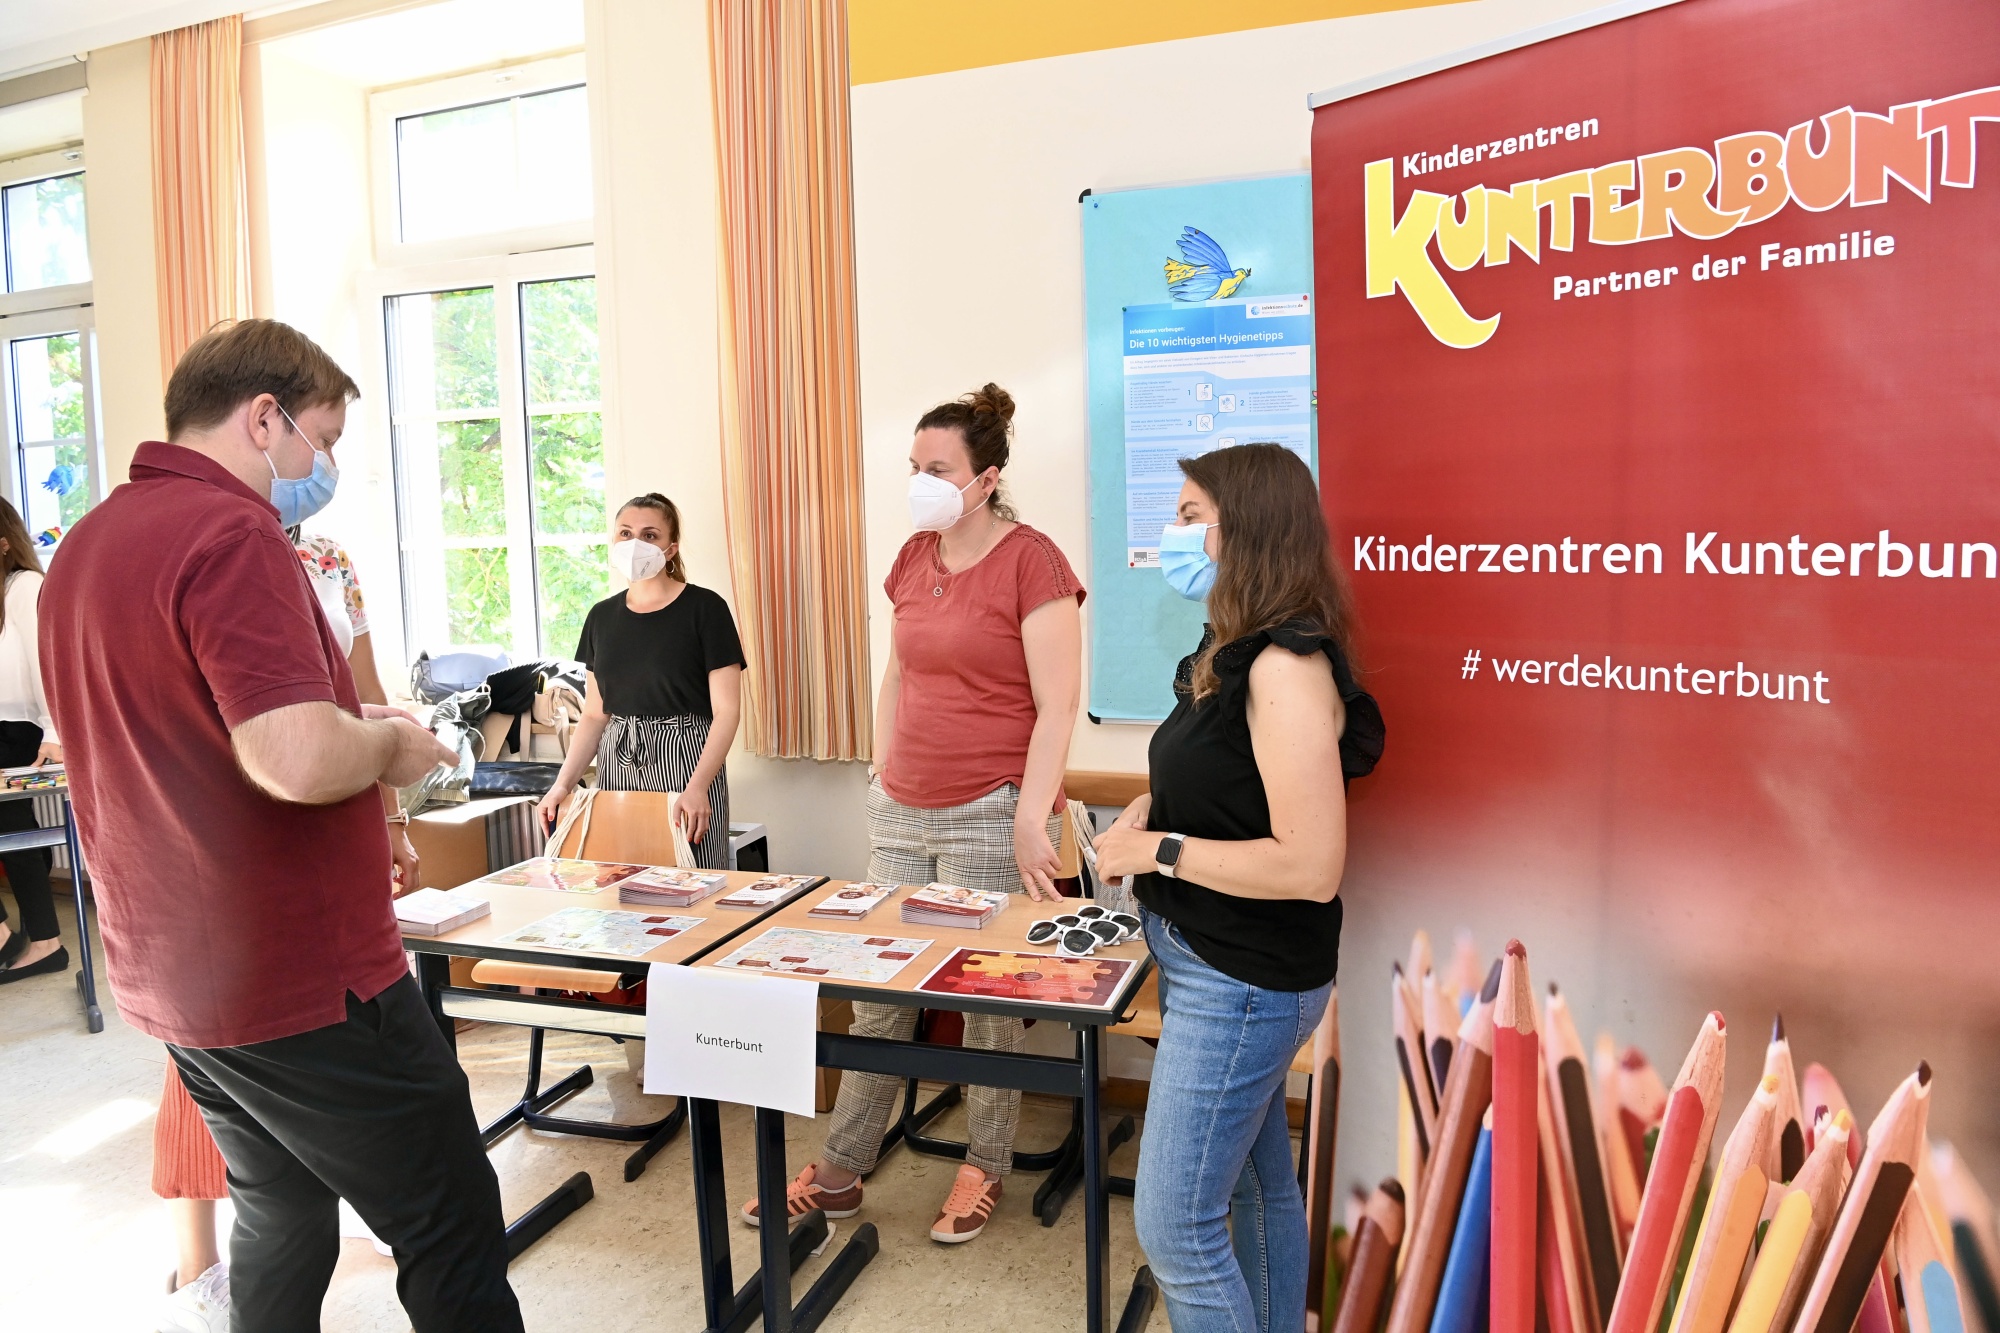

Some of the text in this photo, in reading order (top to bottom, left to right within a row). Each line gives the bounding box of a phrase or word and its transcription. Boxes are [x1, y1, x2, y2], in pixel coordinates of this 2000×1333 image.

[1402, 117, 1599, 178] Kinderzentren
[1553, 230, 1895, 301] Partner der Familie
[1129, 331, 1284, 349] Die 10 wichtigsten Hygienetipps
[1353, 534, 1663, 574] Kinderzentren
[1461, 649, 1831, 704] # werdekunterbunt
[696, 1033, 763, 1053] Kunterbunt
